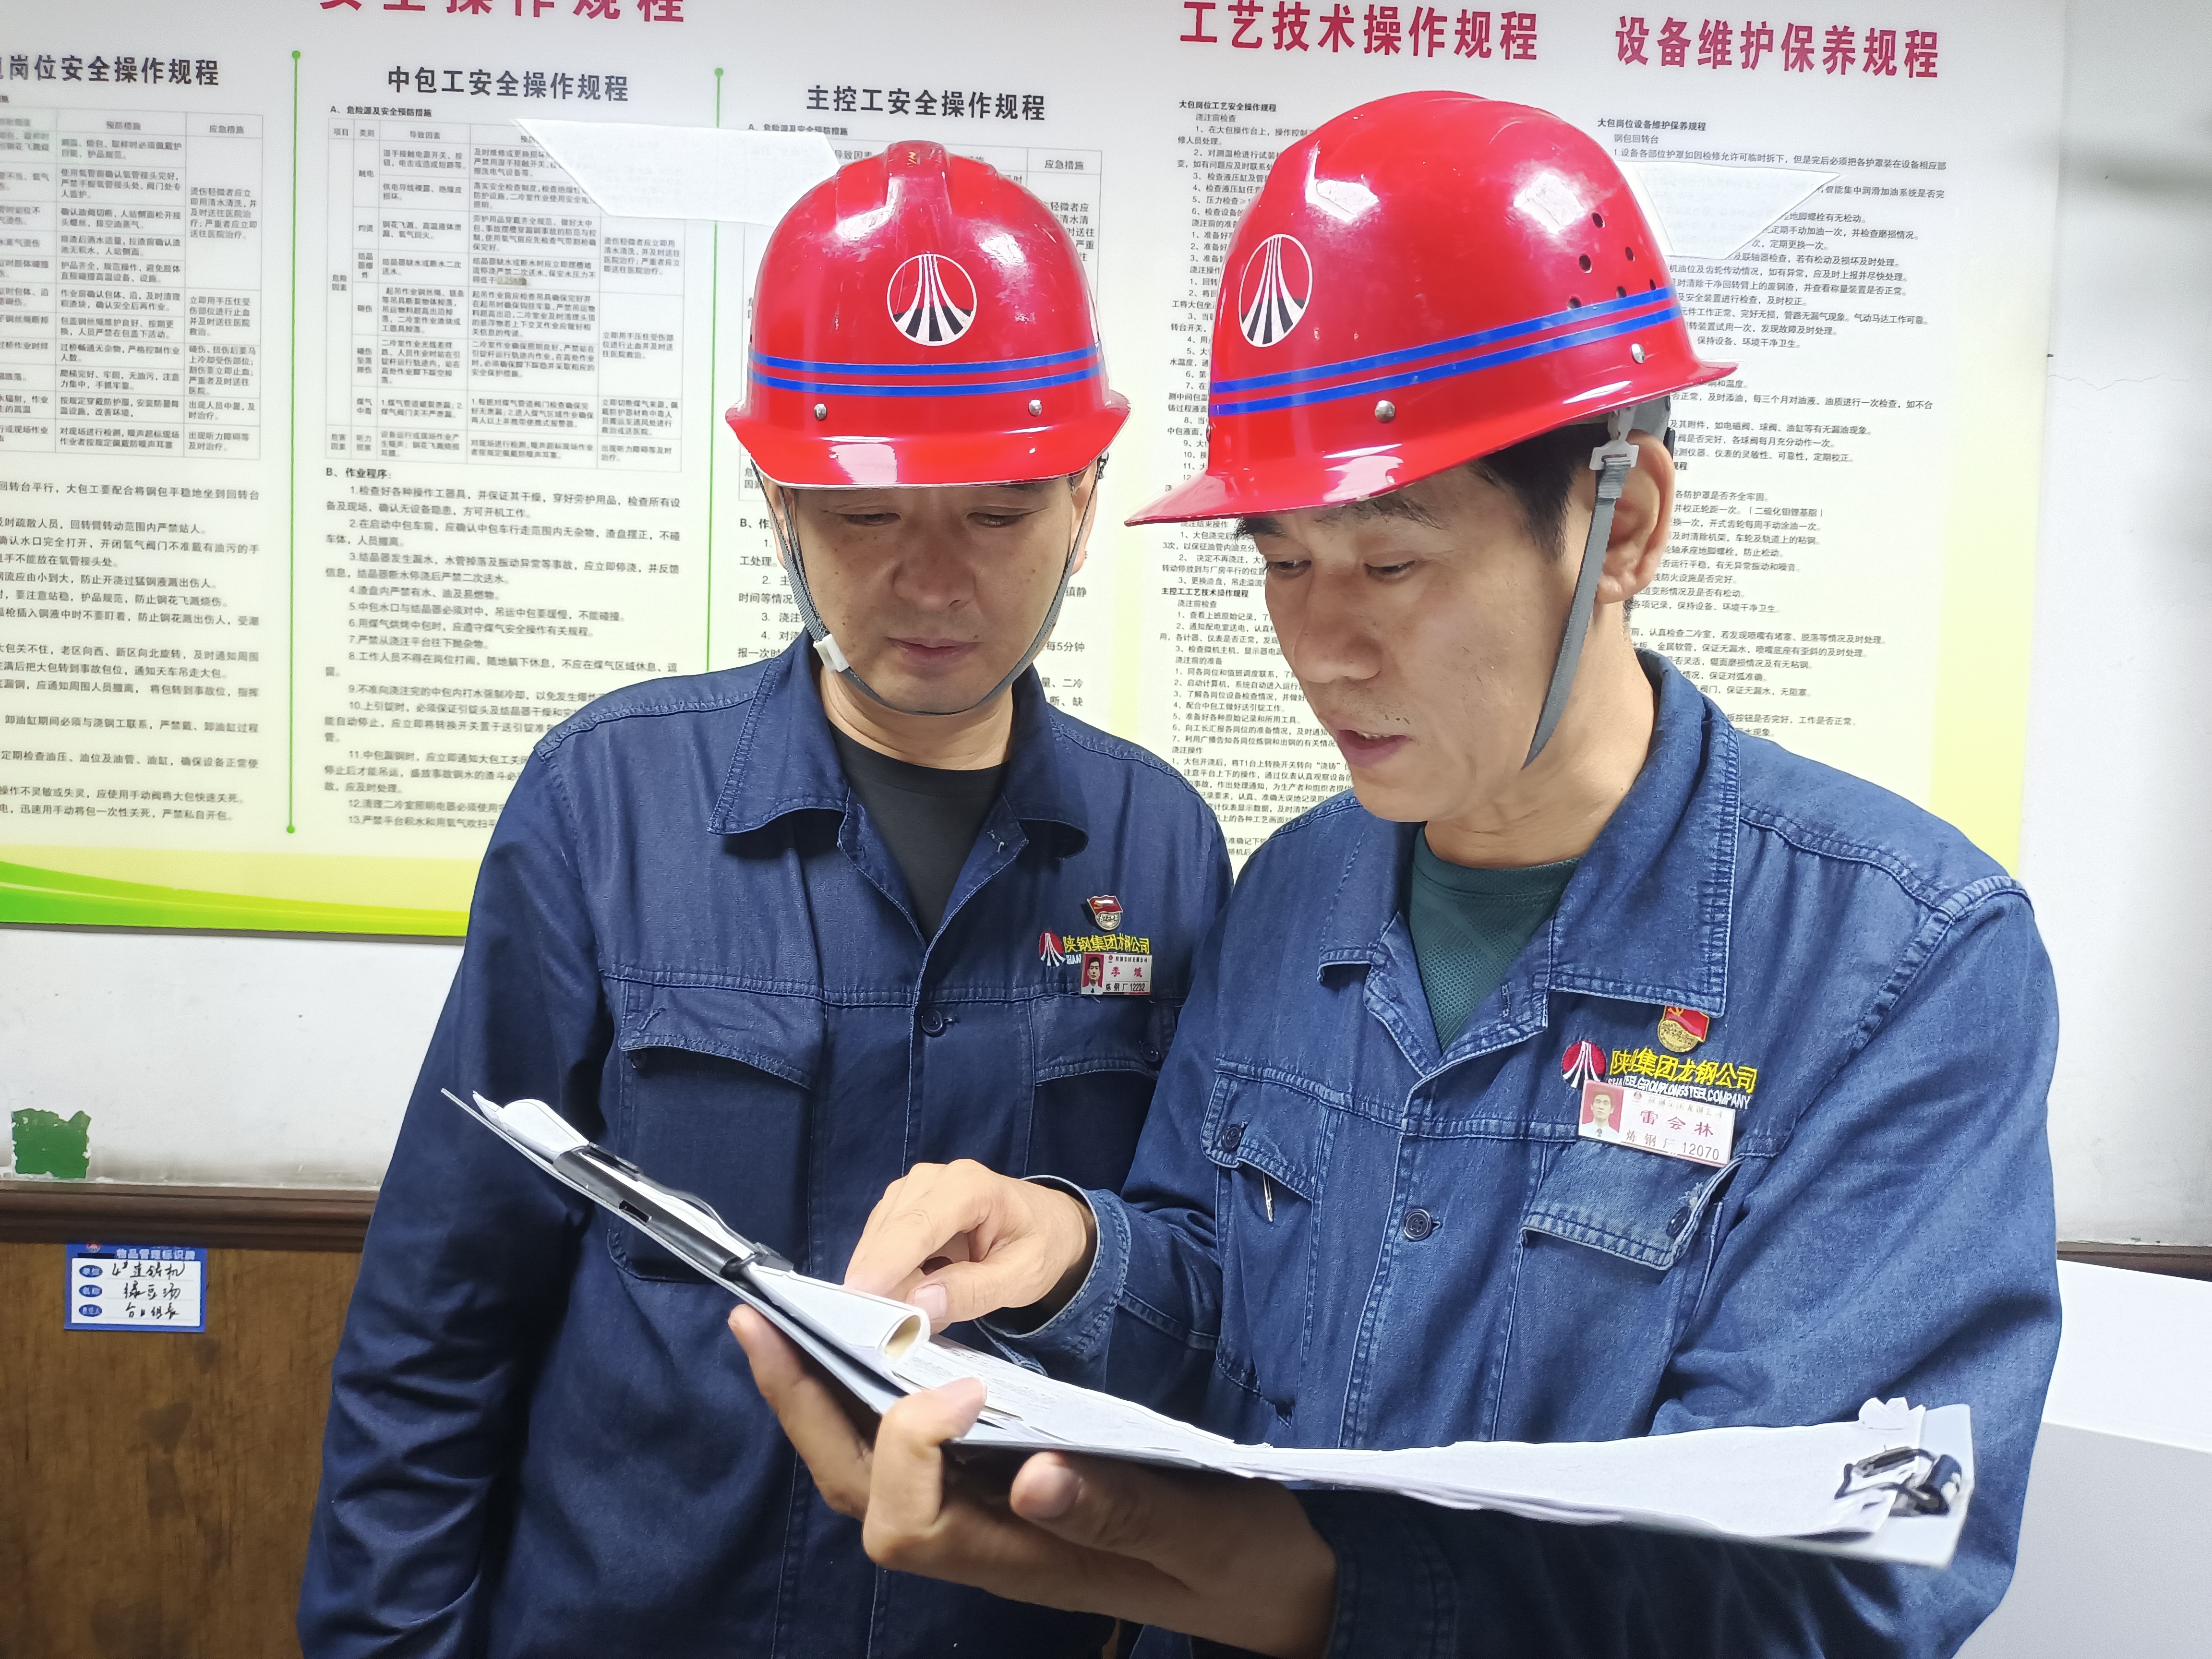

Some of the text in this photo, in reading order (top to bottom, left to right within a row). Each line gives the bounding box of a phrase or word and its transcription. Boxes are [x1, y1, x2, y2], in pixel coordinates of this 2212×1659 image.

[1180, 0, 1537, 60] 工艺技术操作规程
[1615, 15, 1939, 78] 设备维护保养规程
[0, 55, 219, 85] 岗位安全操作规程
[388, 66, 629, 102] 中包工安全操作规程
[806, 85, 1046, 121] 主控工安全操作规程
[1075, 240, 1095, 249] 严重
[1610, 1047, 1758, 1093] 陕集团龙钢公司
[1641, 1110, 1713, 1137] 雷会林
